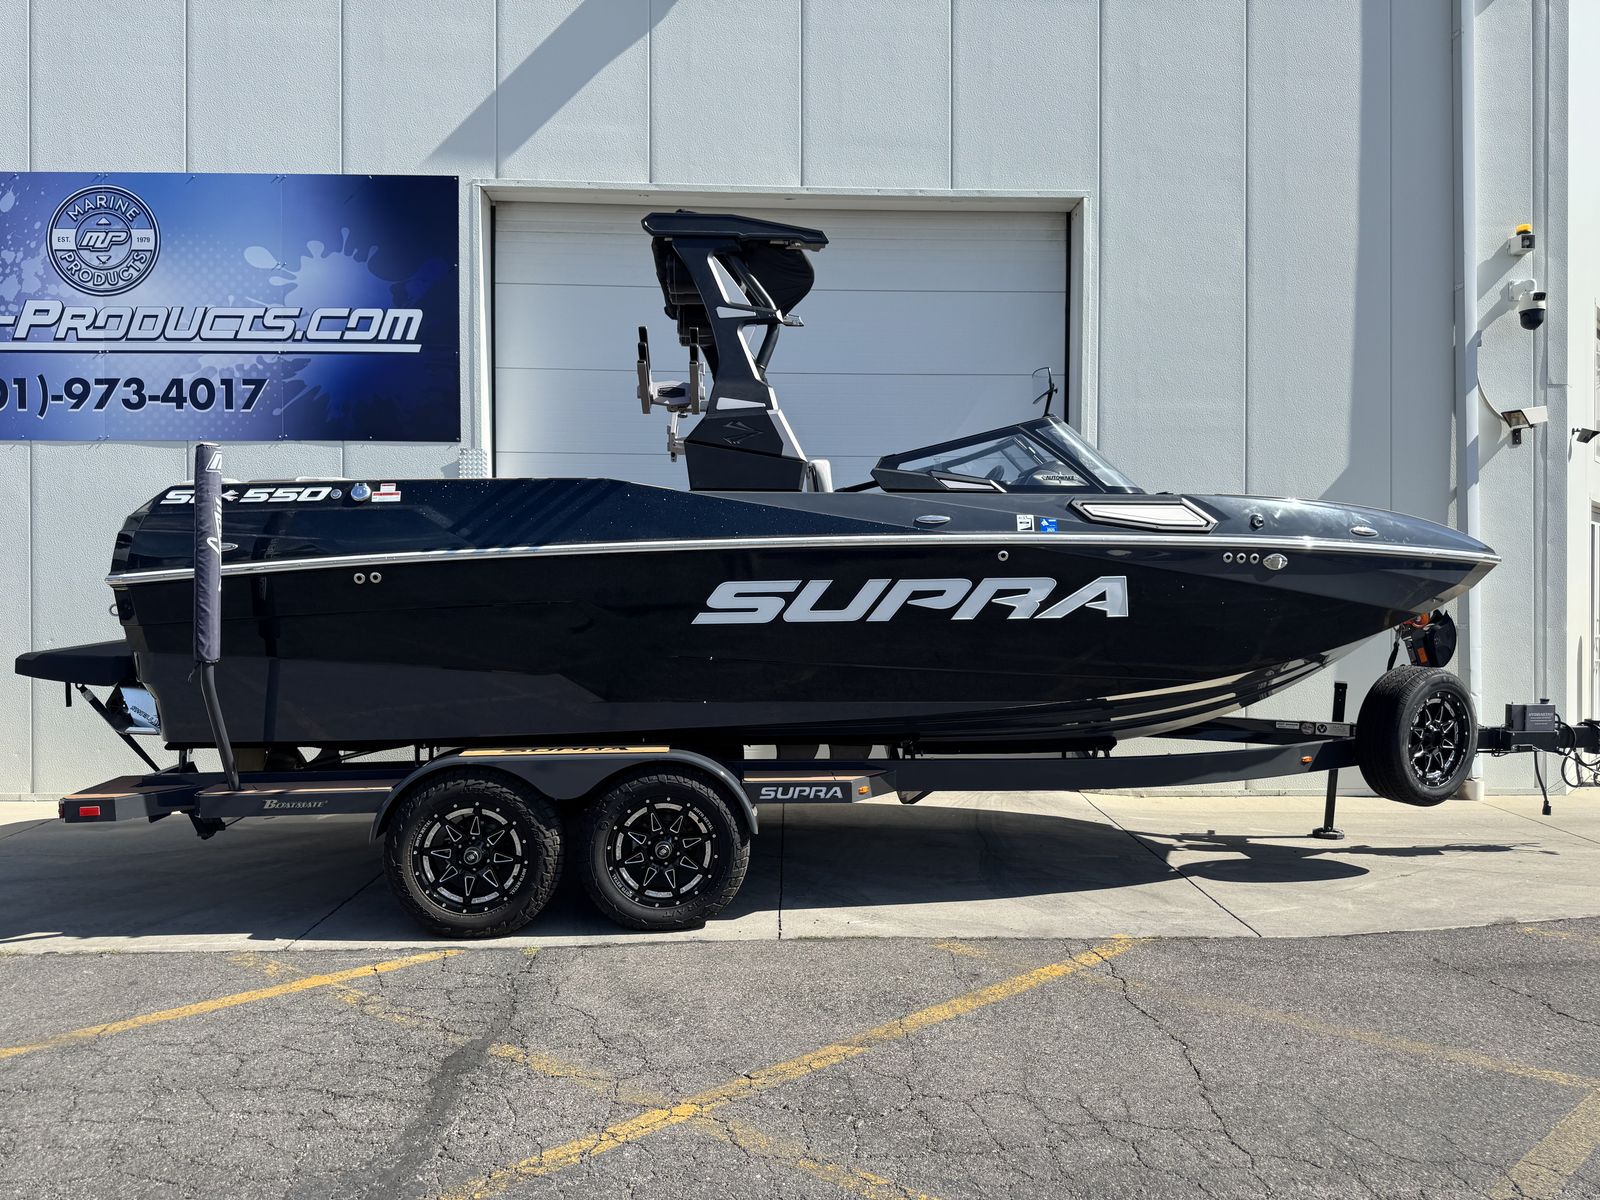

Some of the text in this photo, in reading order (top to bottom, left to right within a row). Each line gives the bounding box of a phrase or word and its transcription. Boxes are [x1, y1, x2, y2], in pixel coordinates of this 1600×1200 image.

[66, 195, 140, 221] MARINE
[61, 251, 147, 286] PRODUCTS
[160, 487, 332, 504] S 550
[691, 575, 1129, 624] SUPRA
[759, 786, 843, 800] SUPRA
